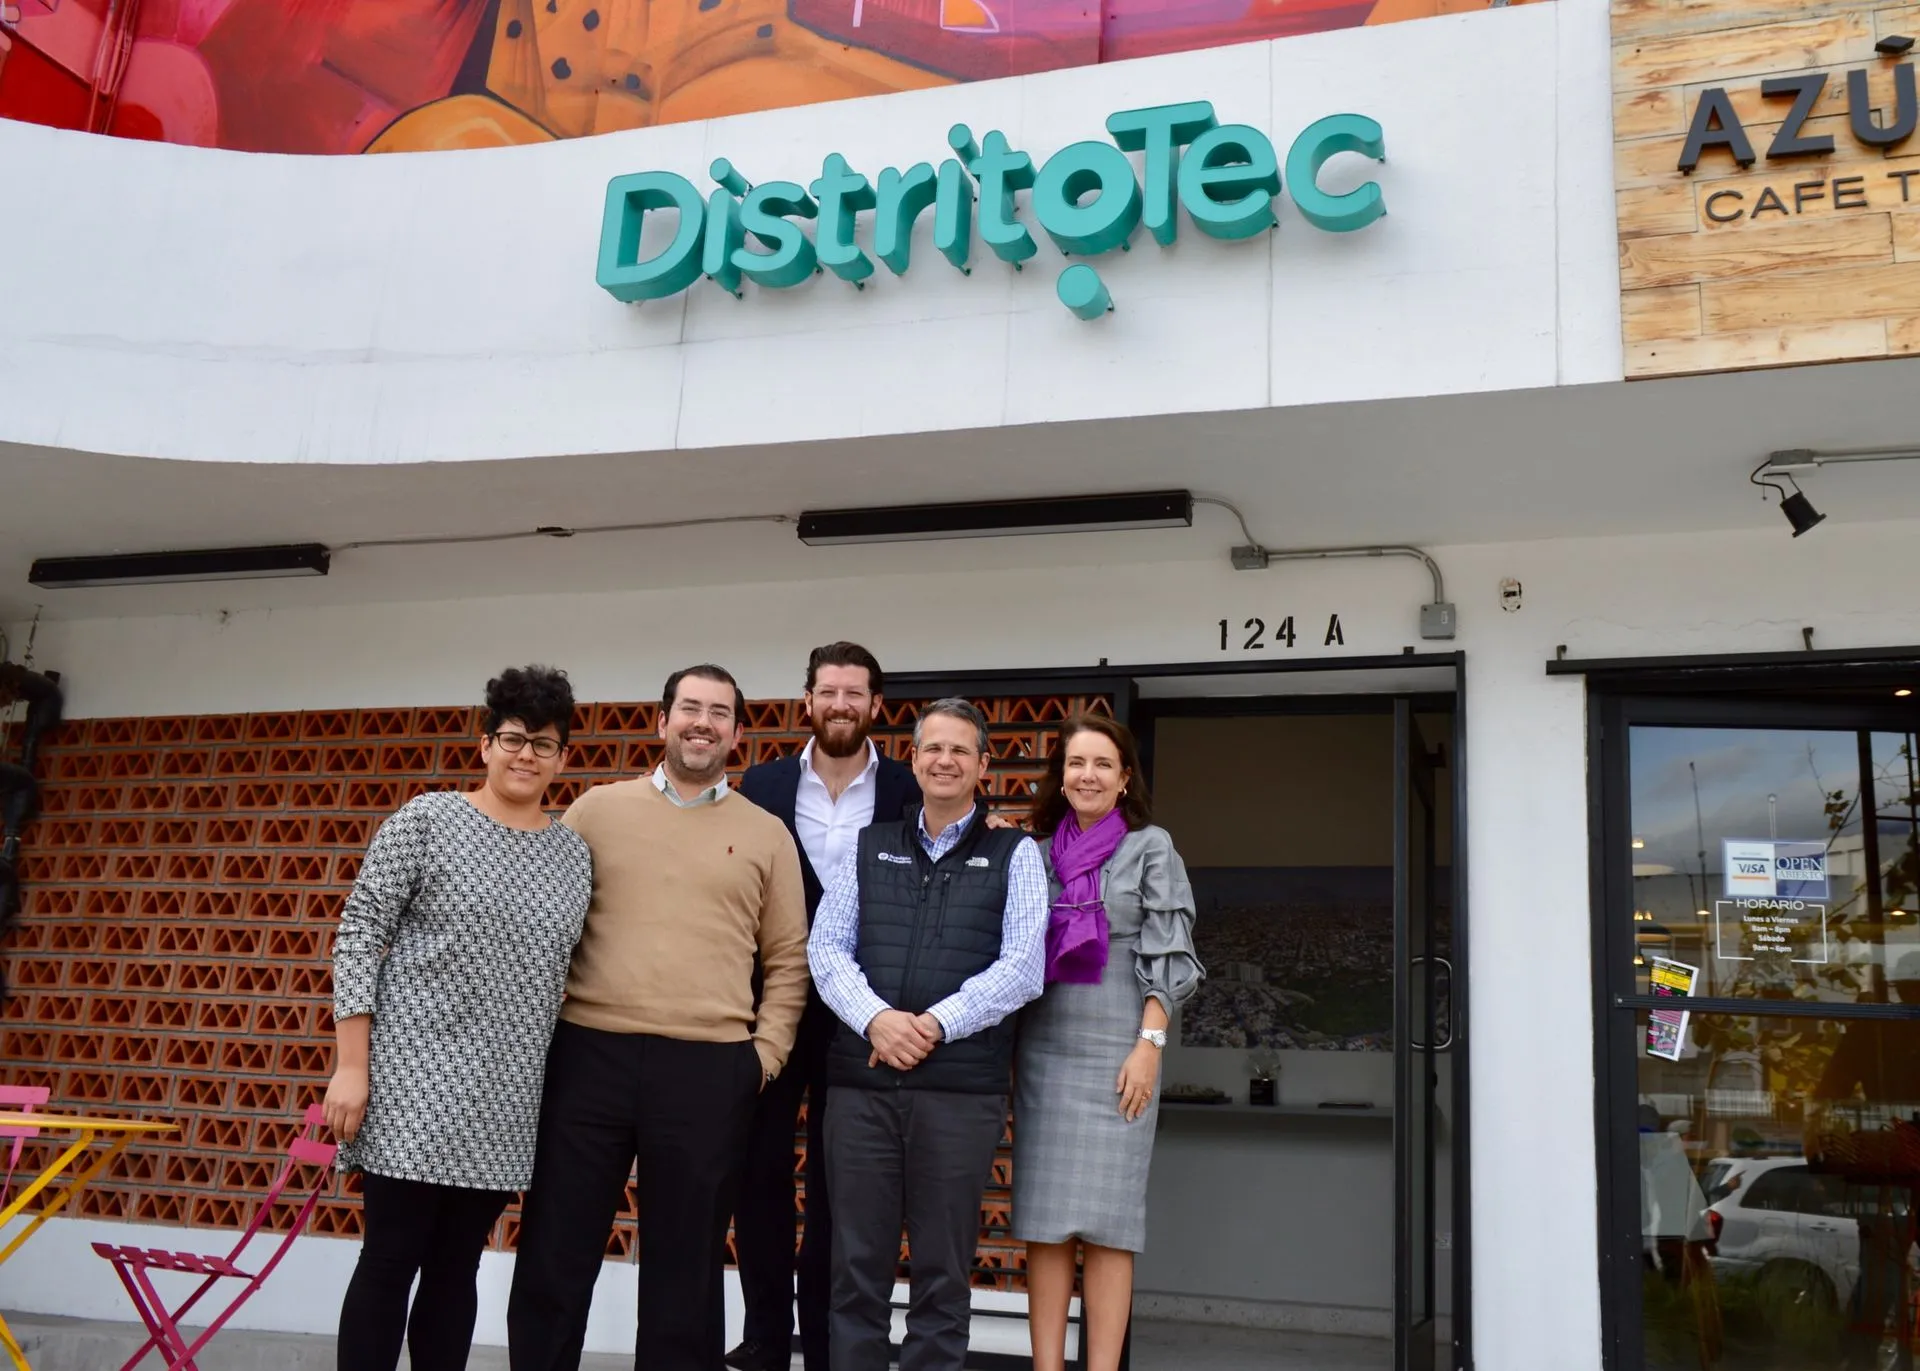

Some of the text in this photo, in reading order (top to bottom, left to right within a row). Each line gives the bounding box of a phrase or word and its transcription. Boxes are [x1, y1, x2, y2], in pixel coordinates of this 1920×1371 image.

[1704, 175, 1868, 222] CAFE
[595, 99, 1387, 321] DistritoTec
[1218, 613, 1345, 651] 124 A
[1739, 863, 1766, 874] VISA
[1776, 856, 1823, 870] OPEN
[1736, 898, 1805, 911] HORARIO
[1743, 915, 1765, 923] Lunes
[1771, 916, 1799, 924] Viernes
